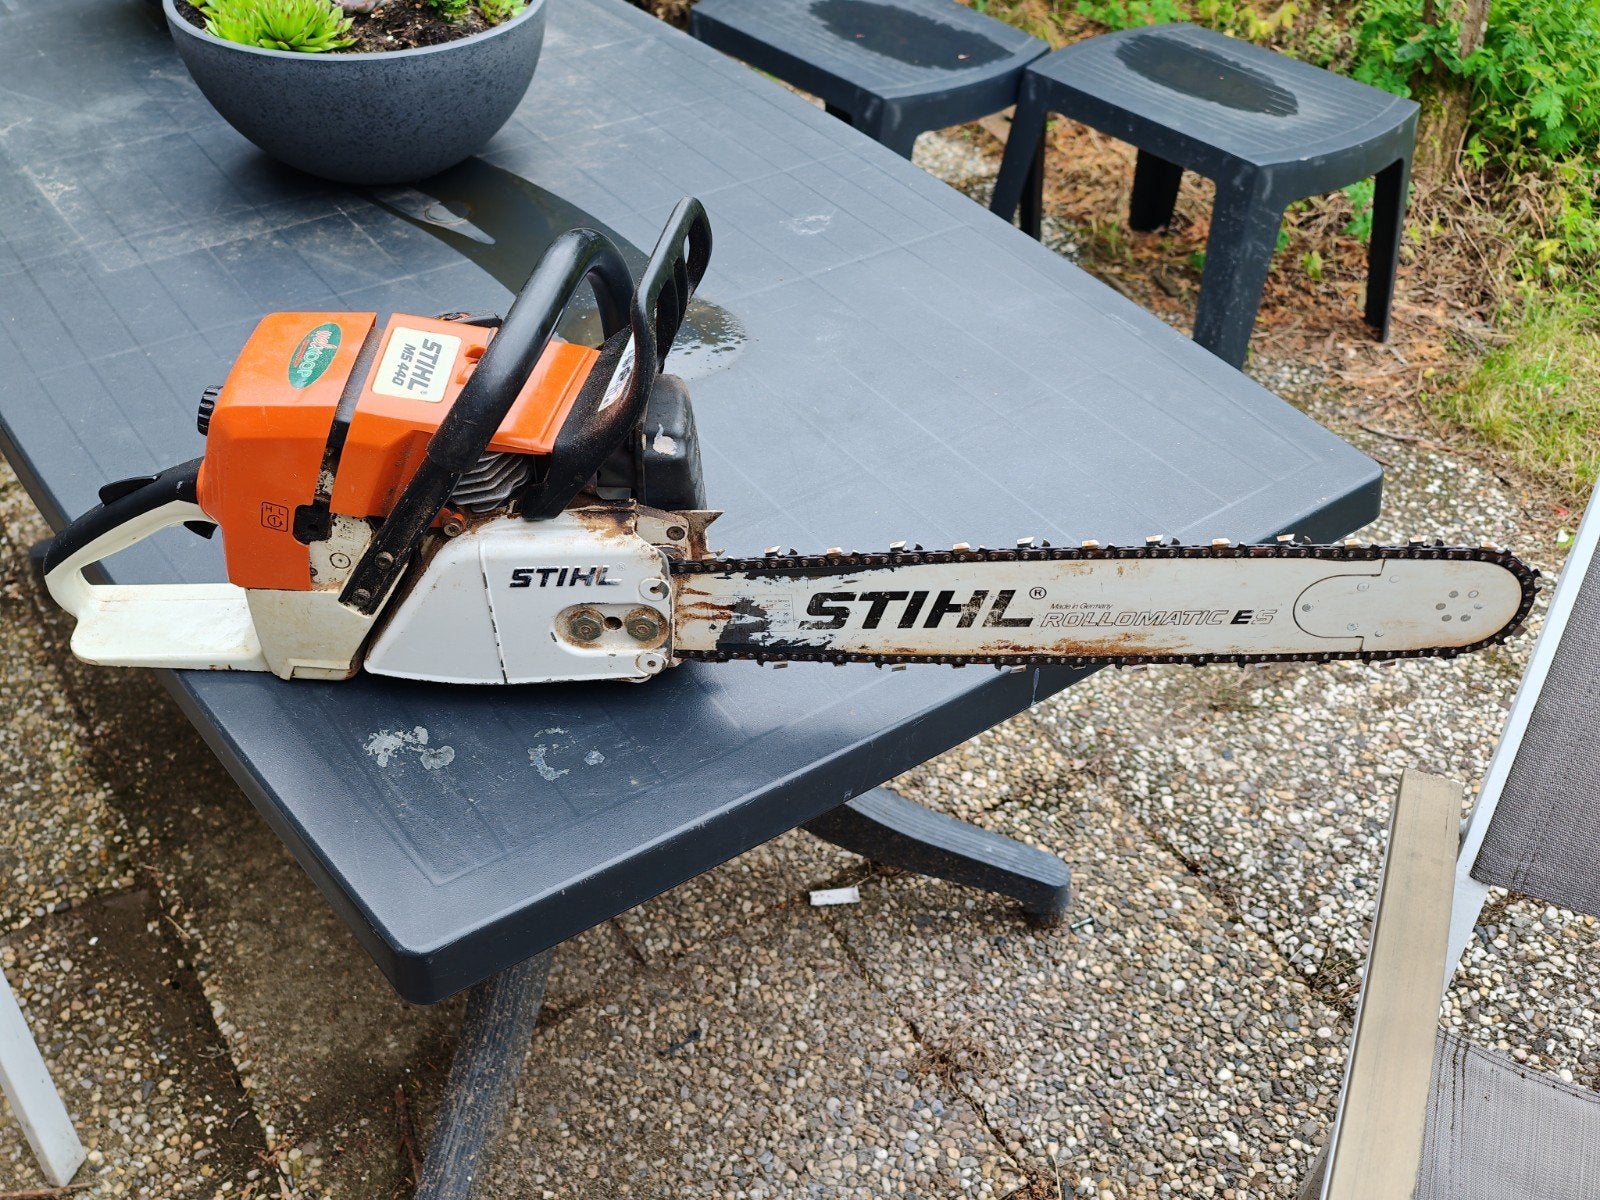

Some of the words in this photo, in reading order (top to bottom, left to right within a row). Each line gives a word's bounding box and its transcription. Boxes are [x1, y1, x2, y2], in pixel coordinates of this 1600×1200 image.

[400, 343, 416, 363] MS
[407, 338, 443, 391] STIHL
[391, 362, 410, 386] 440
[509, 565, 622, 588] STIHL
[798, 589, 1034, 629] STIHL
[1079, 602, 1114, 611] Germany
[1040, 610, 1229, 627] ROLLOMATIC
